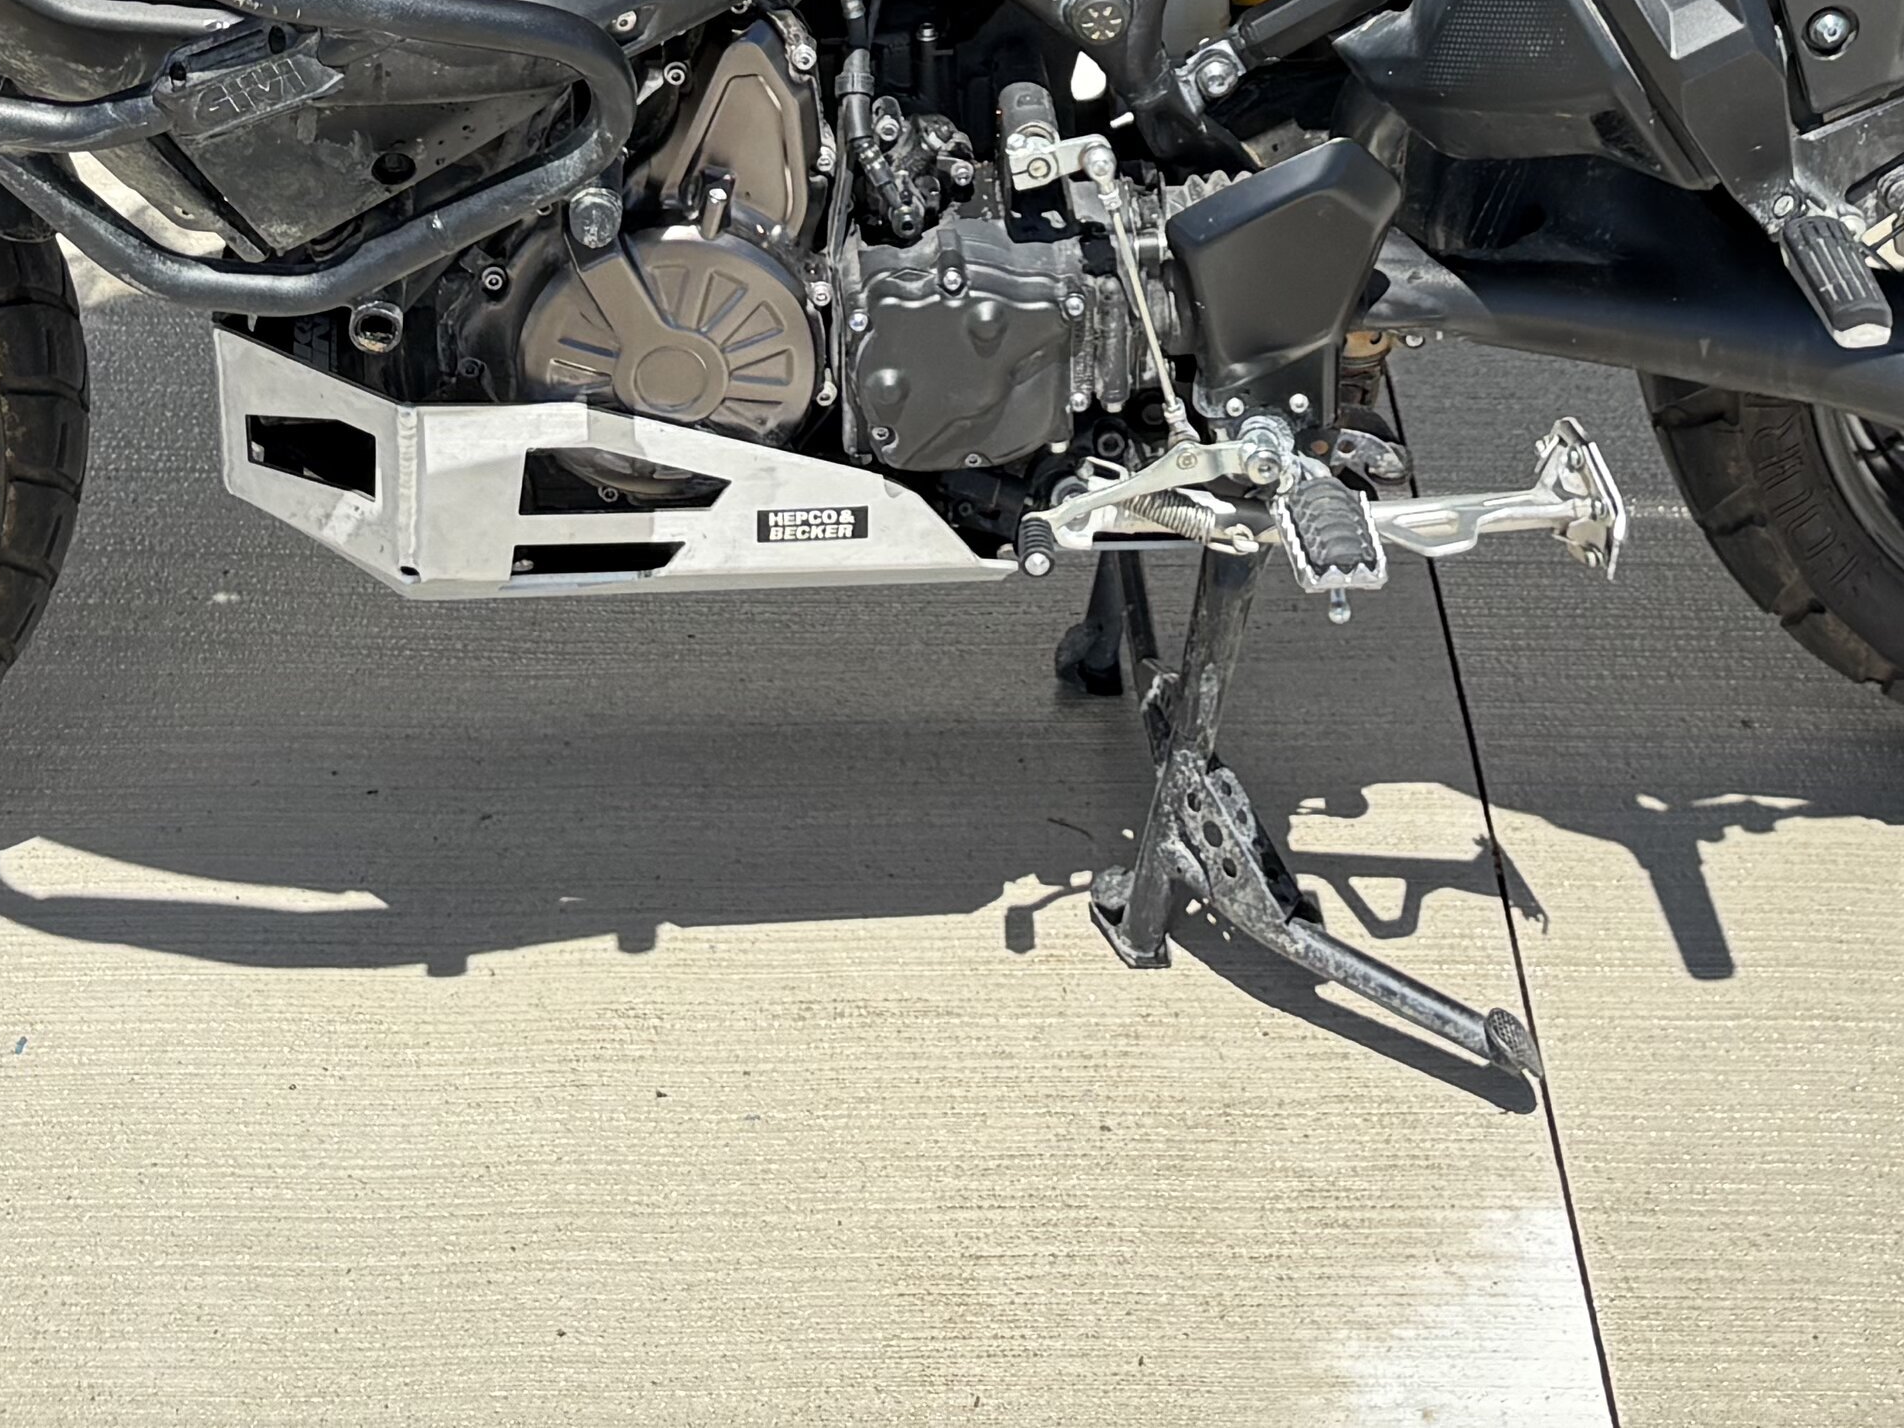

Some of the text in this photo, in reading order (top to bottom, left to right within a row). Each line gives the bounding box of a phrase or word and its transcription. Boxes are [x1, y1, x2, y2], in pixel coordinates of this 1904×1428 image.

[769, 509, 856, 526] HEPCO &
[769, 524, 853, 541] BECKER
